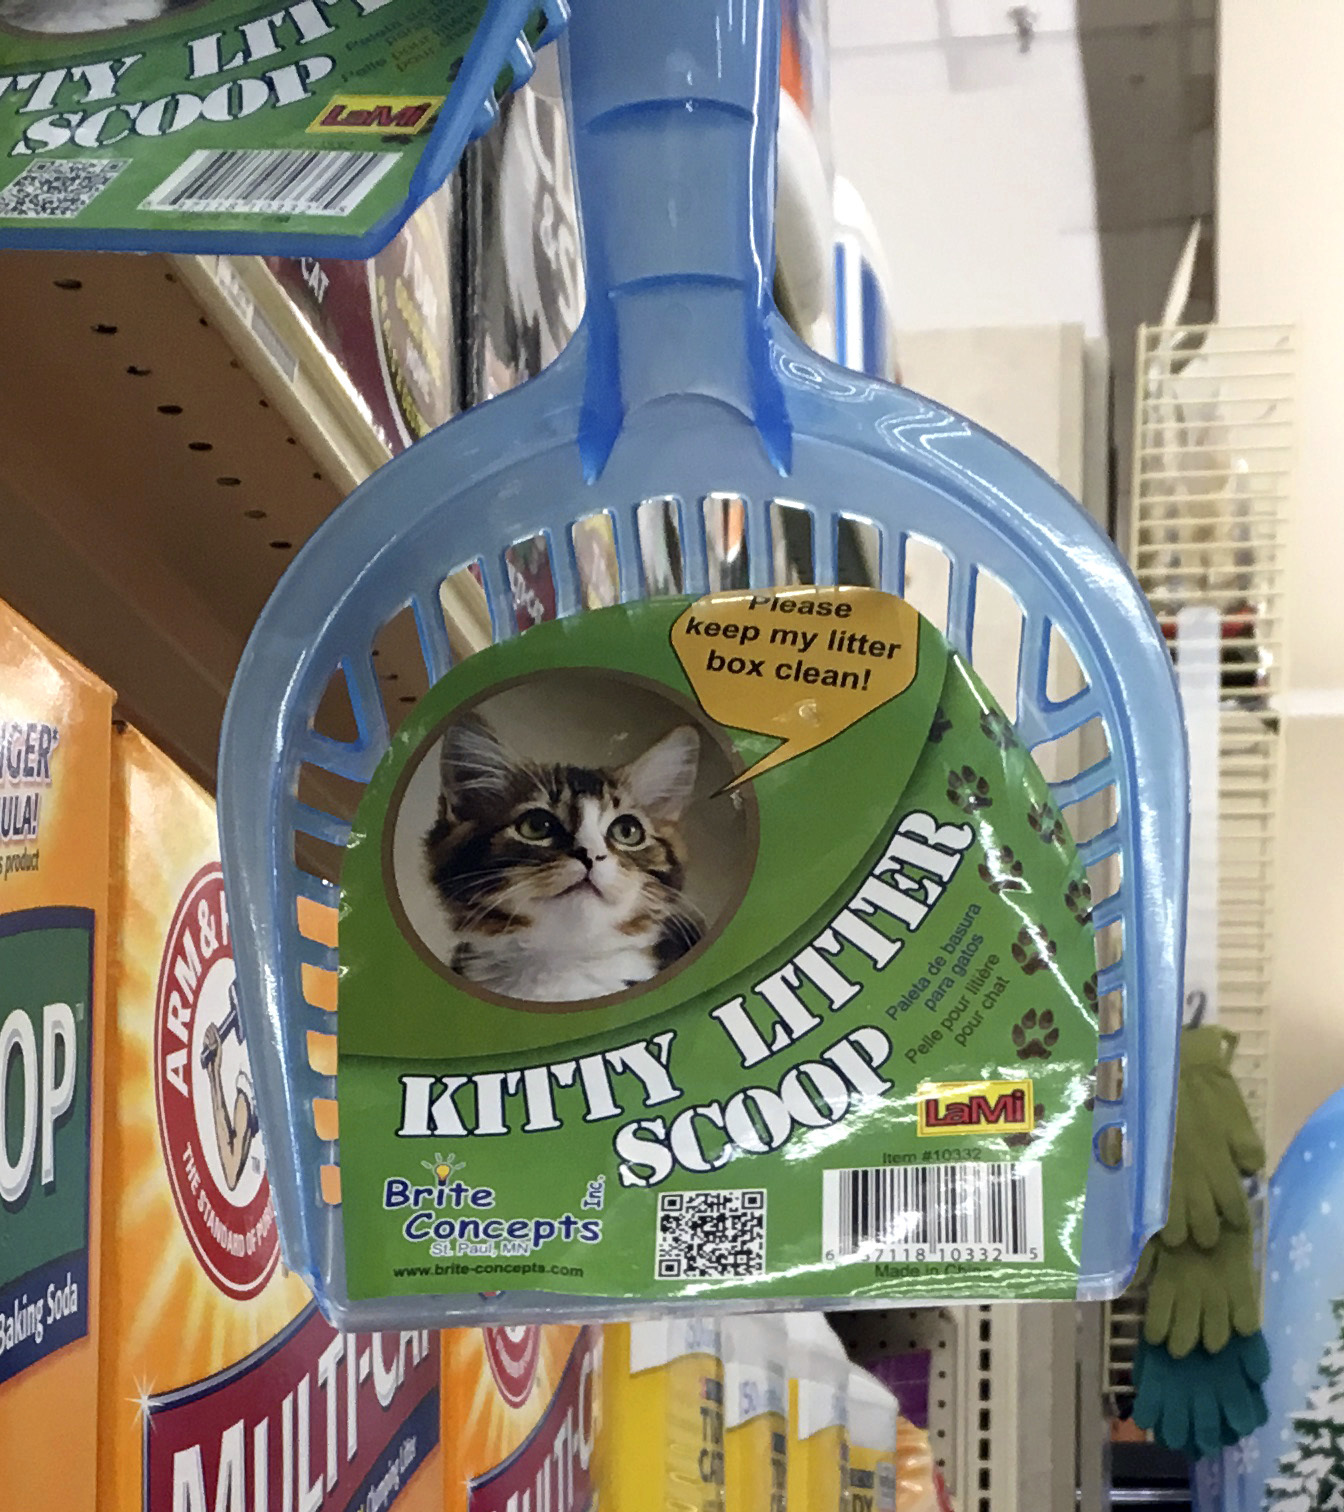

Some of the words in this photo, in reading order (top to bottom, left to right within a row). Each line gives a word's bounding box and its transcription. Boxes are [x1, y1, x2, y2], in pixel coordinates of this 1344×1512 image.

[186, 0, 396, 80] LIT
[9, 56, 337, 157] SCOOP
[320, 103, 433, 127] LaMi
[747, 595, 853, 618] Please
[684, 616, 761, 646] keep
[769, 627, 819, 654] my
[827, 628, 902, 661] litter
[706, 649, 765, 678] box
[775, 660, 873, 692] clean!
[4, 847, 40, 881] product
[396, 1030, 684, 1138] KITTY
[711, 808, 976, 1069] LITTER
[884, 975, 931, 1021] Paleta
[926, 953, 948, 977] de
[939, 902, 983, 956] basura
[923, 973, 956, 1013] para
[950, 932, 984, 978] gatos
[162, 928, 204, 1098] ARM
[196, 897, 219, 962] &
[953, 1009, 987, 1048] pour
[980, 974, 1011, 1011] chat
[903, 1027, 945, 1065] Pelle
[939, 994, 973, 1033] pour
[612, 1023, 895, 1190] SCOOP
[925, 1089, 1026, 1128] LaMi
[182, 1141, 201, 1196] THE
[882, 1151, 918, 1165] Item
[384, 1177, 496, 1210] Brite
[581, 1174, 605, 1211] Inc.
[404, 1210, 604, 1250] Concepts
[502, 1242, 532, 1256] MN
[393, 1261, 585, 1278] www.brite-concepts.com
[825, 1249, 836, 1262] 6
[1029, 1246, 1039, 1261] 5
[874, 1264, 920, 1278] Made
[46, 1271, 79, 1325] Soda
